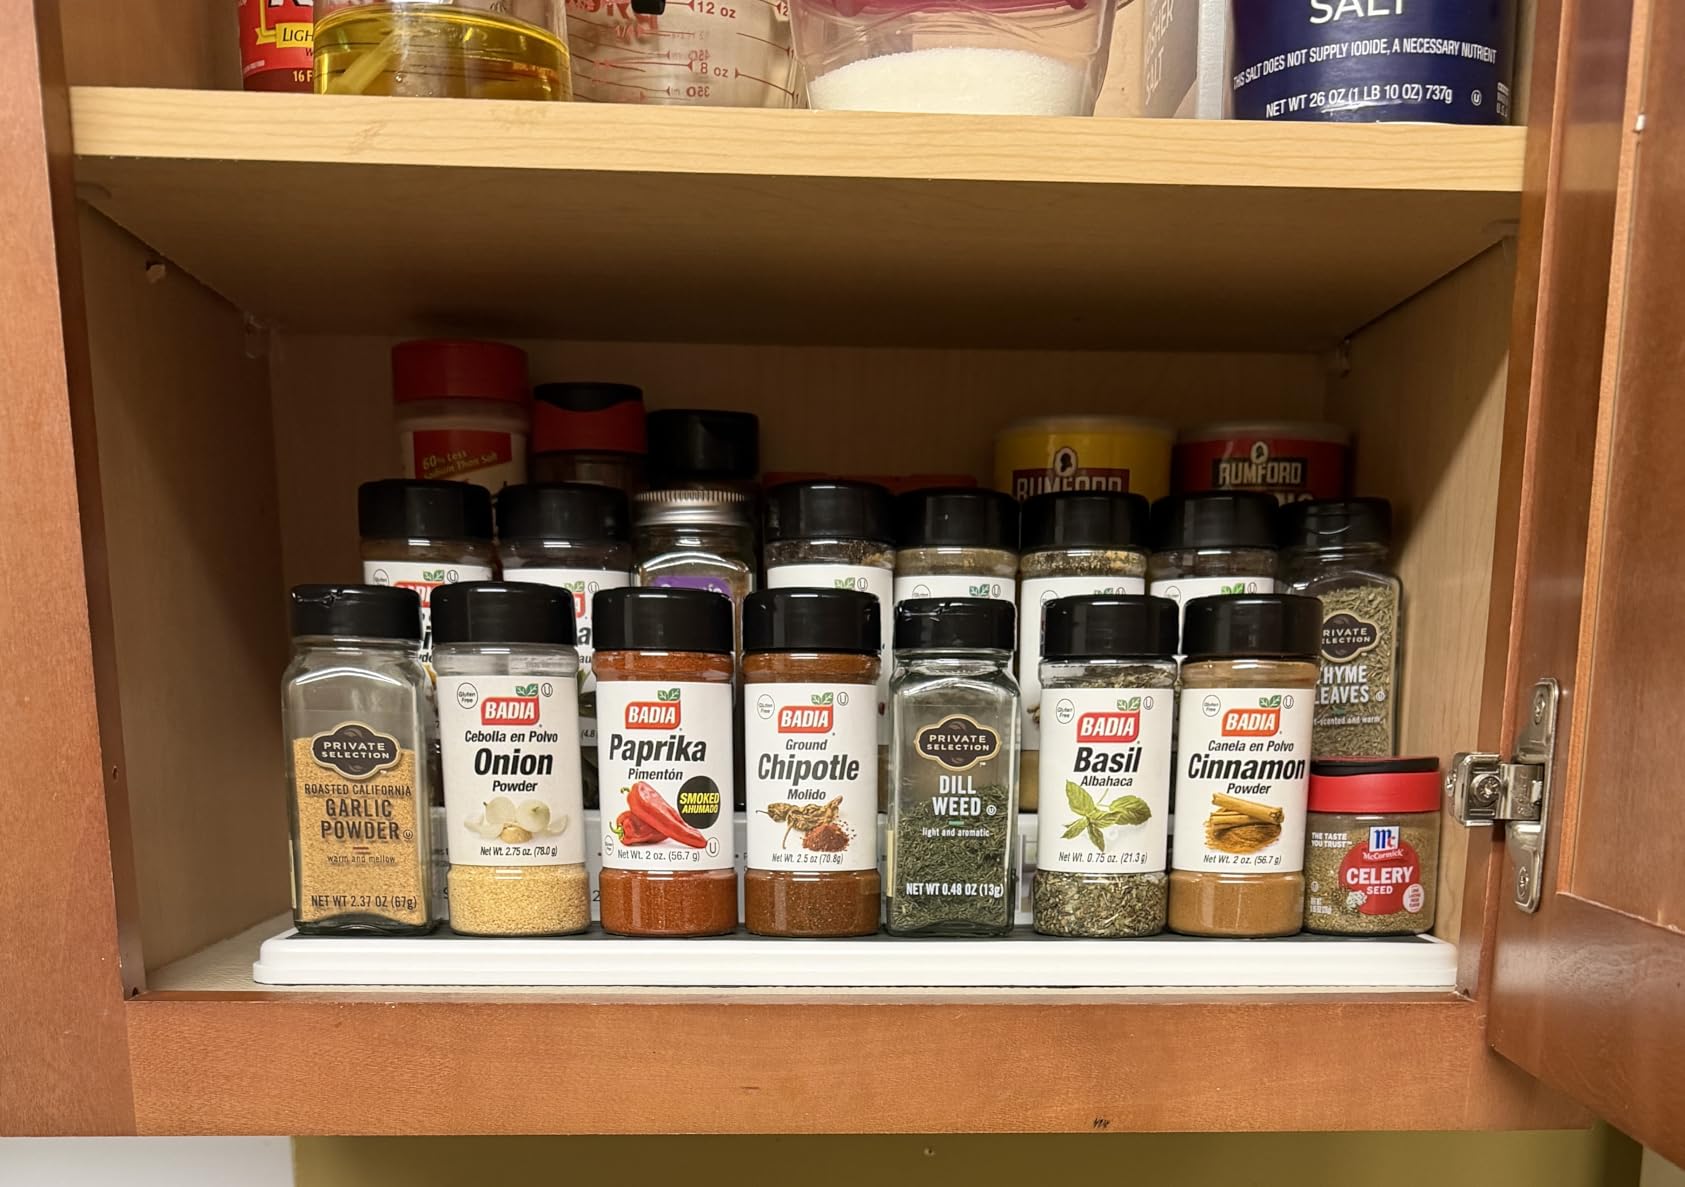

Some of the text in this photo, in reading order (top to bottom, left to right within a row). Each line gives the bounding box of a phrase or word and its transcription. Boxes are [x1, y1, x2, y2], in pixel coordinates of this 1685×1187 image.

[697, 1, 737, 18] 12 oz
[283, 28, 313, 42] LIGH
[700, 62, 708, 74] 8
[1233, 38, 1496, 90] THIS SALT DOES NOT SUPPLY IODIDE, A NECESSARY NUTRIENT
[293, 70, 304, 82] 16
[1266, 84, 1453, 118] NET WT 26 OZ (1 LB 10 OZ) 737g
[1218, 461, 1302, 485] RUMFORD
[1322, 627, 1368, 636] RIVATE
[485, 702, 534, 719] BADIA
[628, 706, 676, 724] BADIA
[781, 710, 828, 728] BADIA
[1225, 713, 1275, 730] BADIA
[1080, 717, 1134, 736] BADIA
[465, 730, 558, 742] Cebolla en Polvo
[930, 734, 986, 743] PRIVATE
[324, 742, 385, 750] PRIVATE
[610, 734, 706, 766] Paprika
[786, 739, 828, 750] Ground
[1208, 740, 1294, 752] Canela en Polvo
[322, 751, 390, 759] SELECTION
[1074, 747, 1142, 773] Basil
[474, 748, 553, 775] Onion
[1188, 753, 1305, 780] Cinnamon
[628, 768, 683, 780] Pimentón
[758, 753, 860, 786] Chipotle
[492, 780, 538, 792] Powder
[940, 776, 976, 794] DILL
[1080, 776, 1132, 786] Albahaca
[304, 784, 412, 796] ROASTED CALIFORNIA
[787, 789, 826, 800] Molido
[1226, 784, 1271, 794] Powder
[680, 792, 720, 804] SMOKED
[326, 798, 392, 817] GARLIC
[682, 804, 718, 814] AHUMADO
[932, 797, 981, 816] WEED
[322, 820, 400, 840] POWDER
[922, 828, 990, 838] light and aromatic
[1324, 832, 1348, 840] TASTE
[480, 846, 492, 856] Net
[506, 847, 520, 856] 2.75
[534, 846, 550, 858] (78.0
[551, 846, 558, 857] g)
[618, 850, 629, 859] Net
[631, 850, 642, 860] Wt.
[646, 851, 651, 860] 2
[668, 852, 690, 862] (56.7
[692, 852, 700, 862] g)
[1058, 852, 1148, 864] Net Wt. 0.75 oz. (21.3 g)
[1362, 849, 1404, 860] McCormick
[352, 855, 366, 863] and
[369, 854, 395, 863] mellow
[772, 854, 782, 862] Net
[784, 854, 794, 863] Wt.
[796, 854, 808, 863] 2.5
[820, 854, 844, 864] (70.8g)
[1204, 854, 1216, 864] Net
[1218, 855, 1230, 864] Wt.
[1232, 856, 1238, 864] 2
[1254, 856, 1273, 866] (56.7
[1274, 856, 1282, 866] g)
[1346, 866, 1414, 884] CELERY
[906, 883, 1004, 898] NET WT 0.48 OZ (13g)
[1366, 885, 1393, 895] SEED
[312, 896, 416, 910] NET WT 2.37 OZ (67g)
